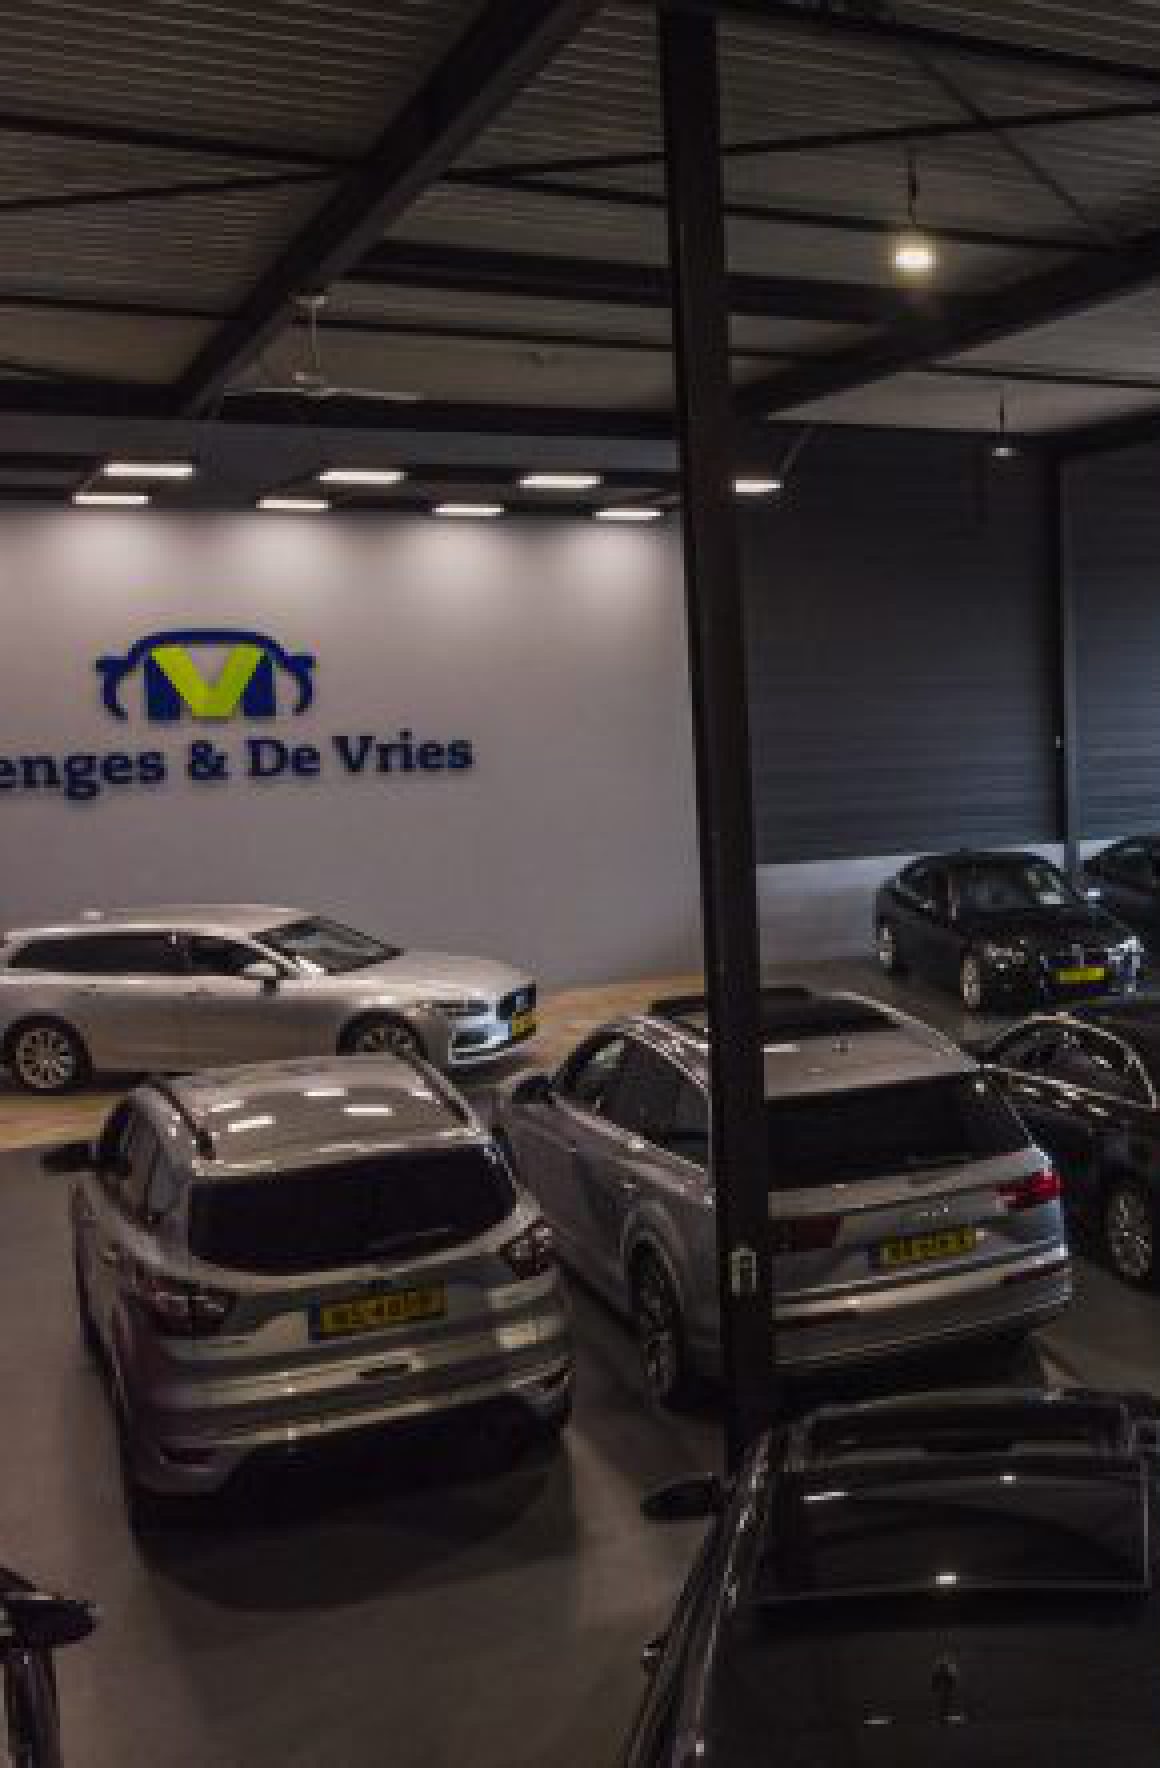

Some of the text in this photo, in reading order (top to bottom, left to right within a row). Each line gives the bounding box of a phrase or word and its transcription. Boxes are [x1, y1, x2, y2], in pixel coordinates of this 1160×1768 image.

[187, 739, 230, 781] &
[246, 738, 321, 777] De
[331, 728, 474, 774] Vries
